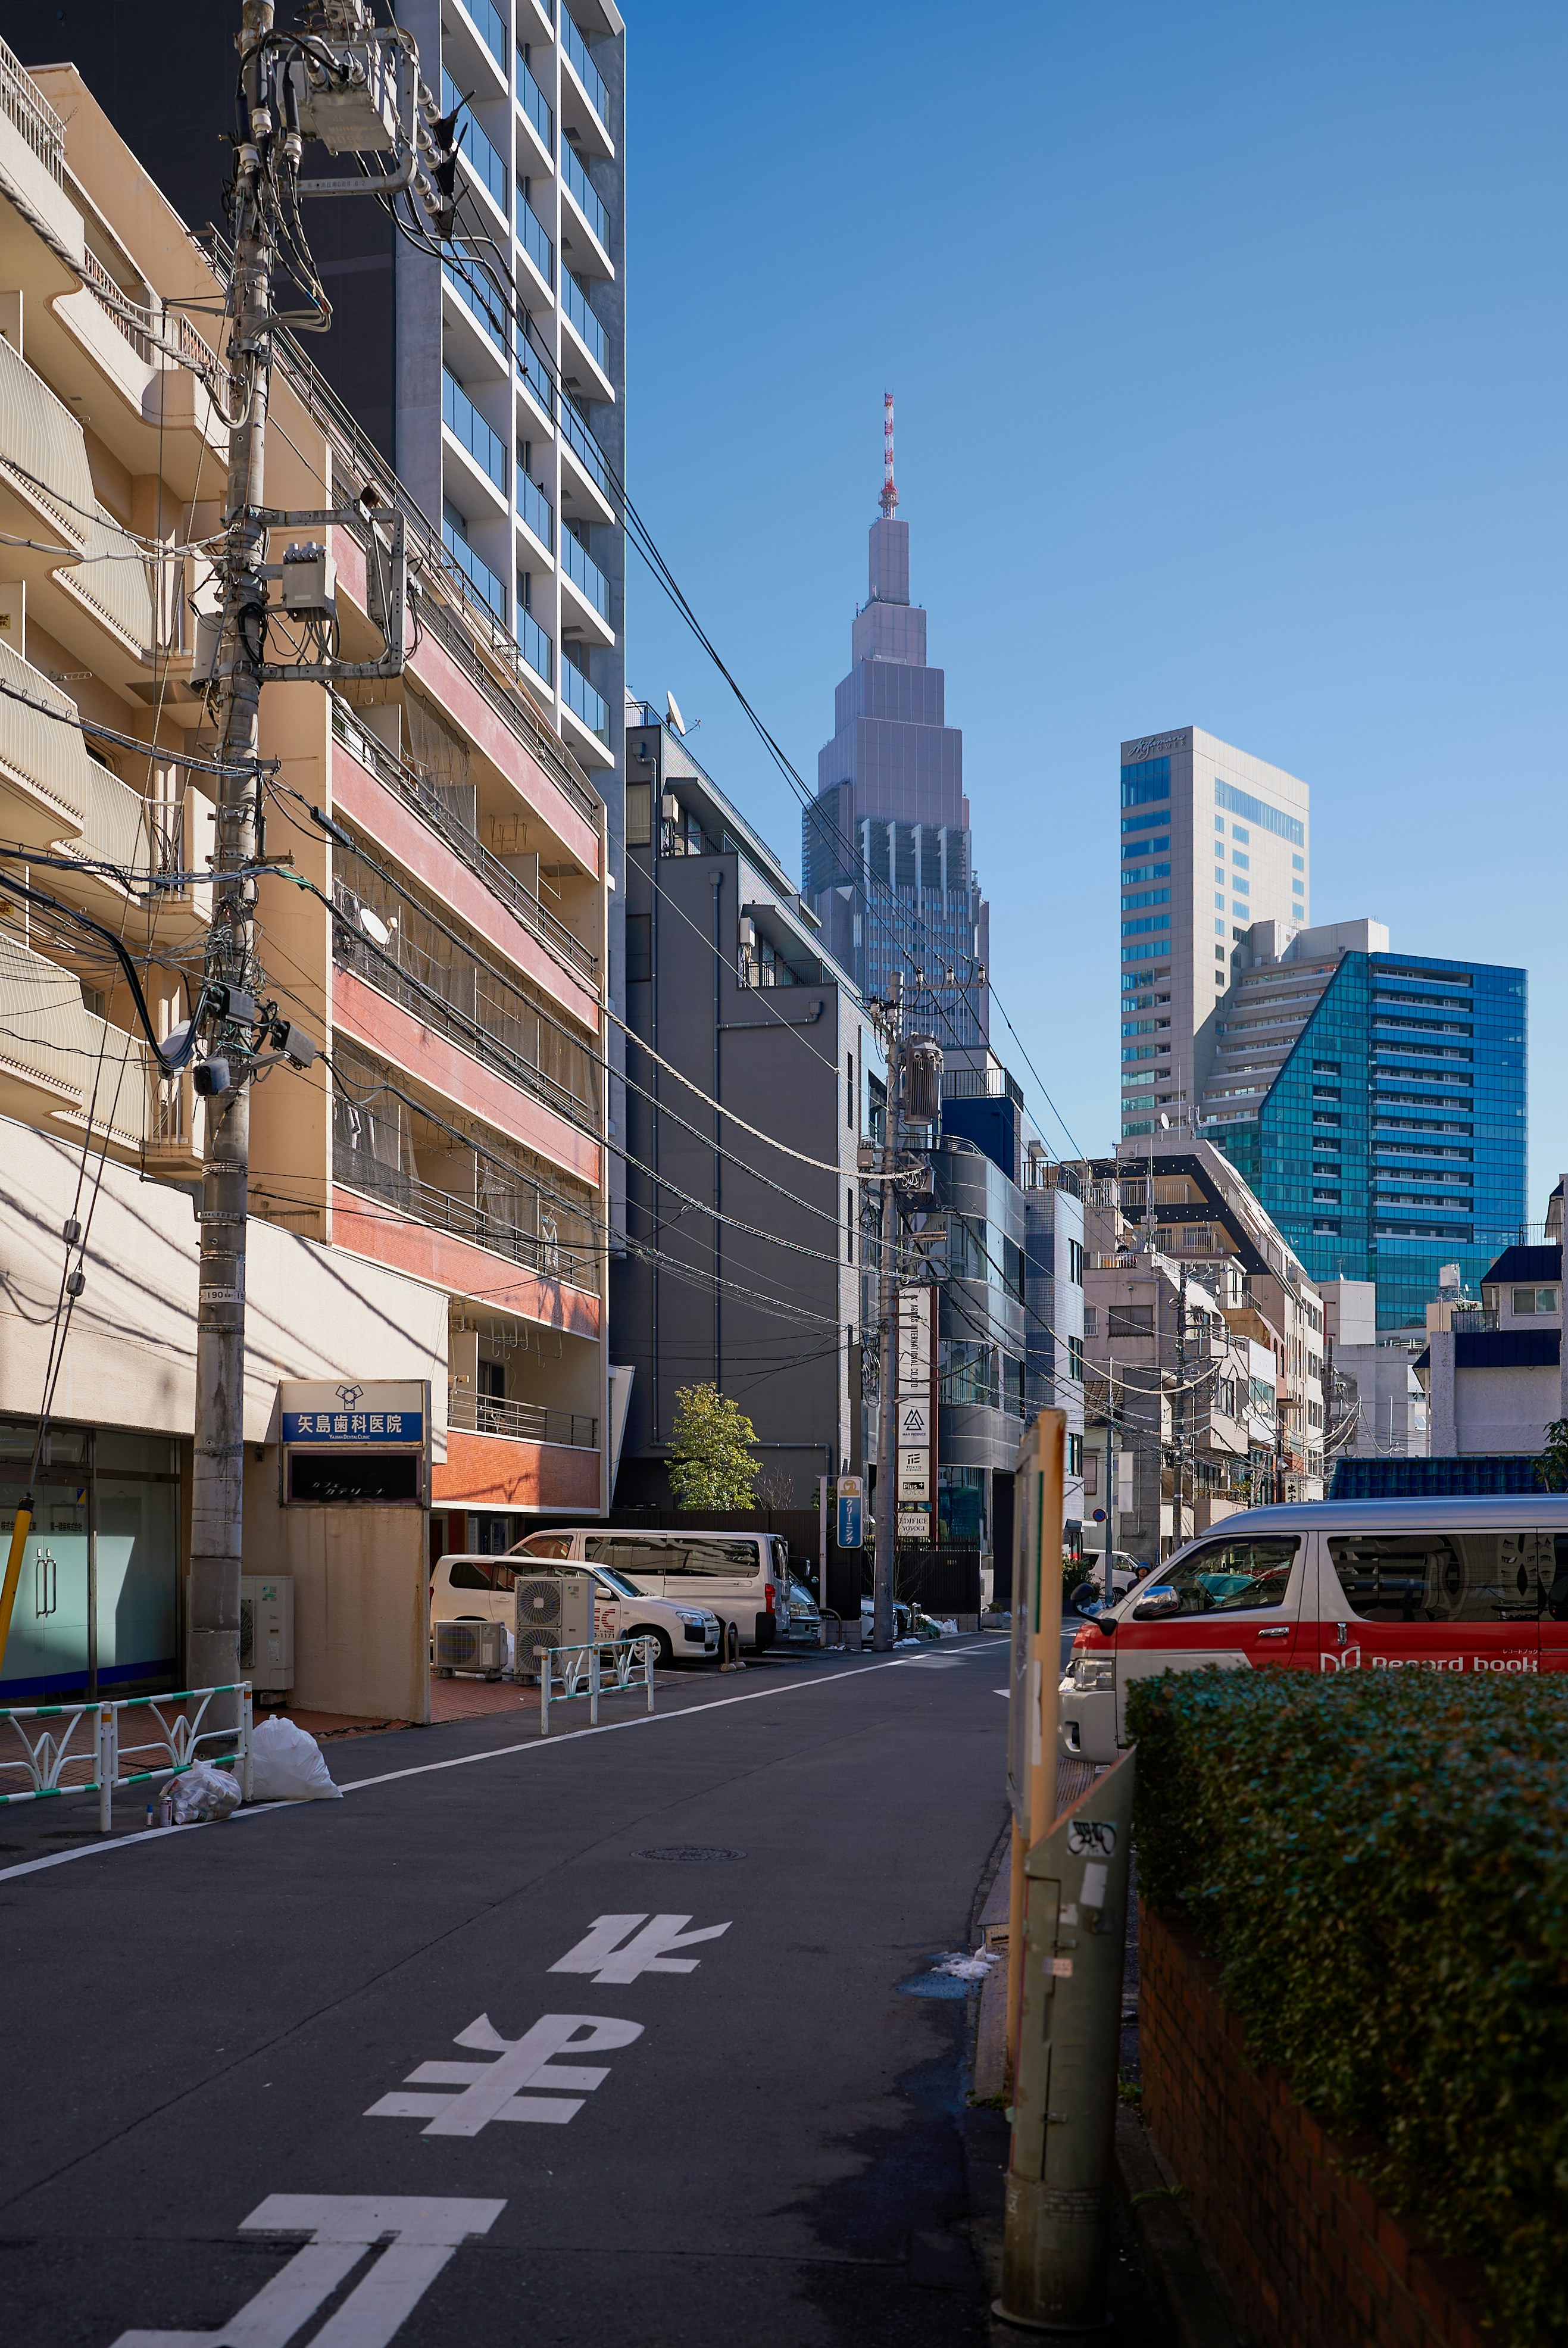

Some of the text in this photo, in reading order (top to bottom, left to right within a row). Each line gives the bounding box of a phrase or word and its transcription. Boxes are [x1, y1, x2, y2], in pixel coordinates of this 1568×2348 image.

[1151, 741, 1185, 753] TOWER
[298, 1415, 402, 1433] 矢島歯科医院
[1473, 1657, 1538, 1672] book
